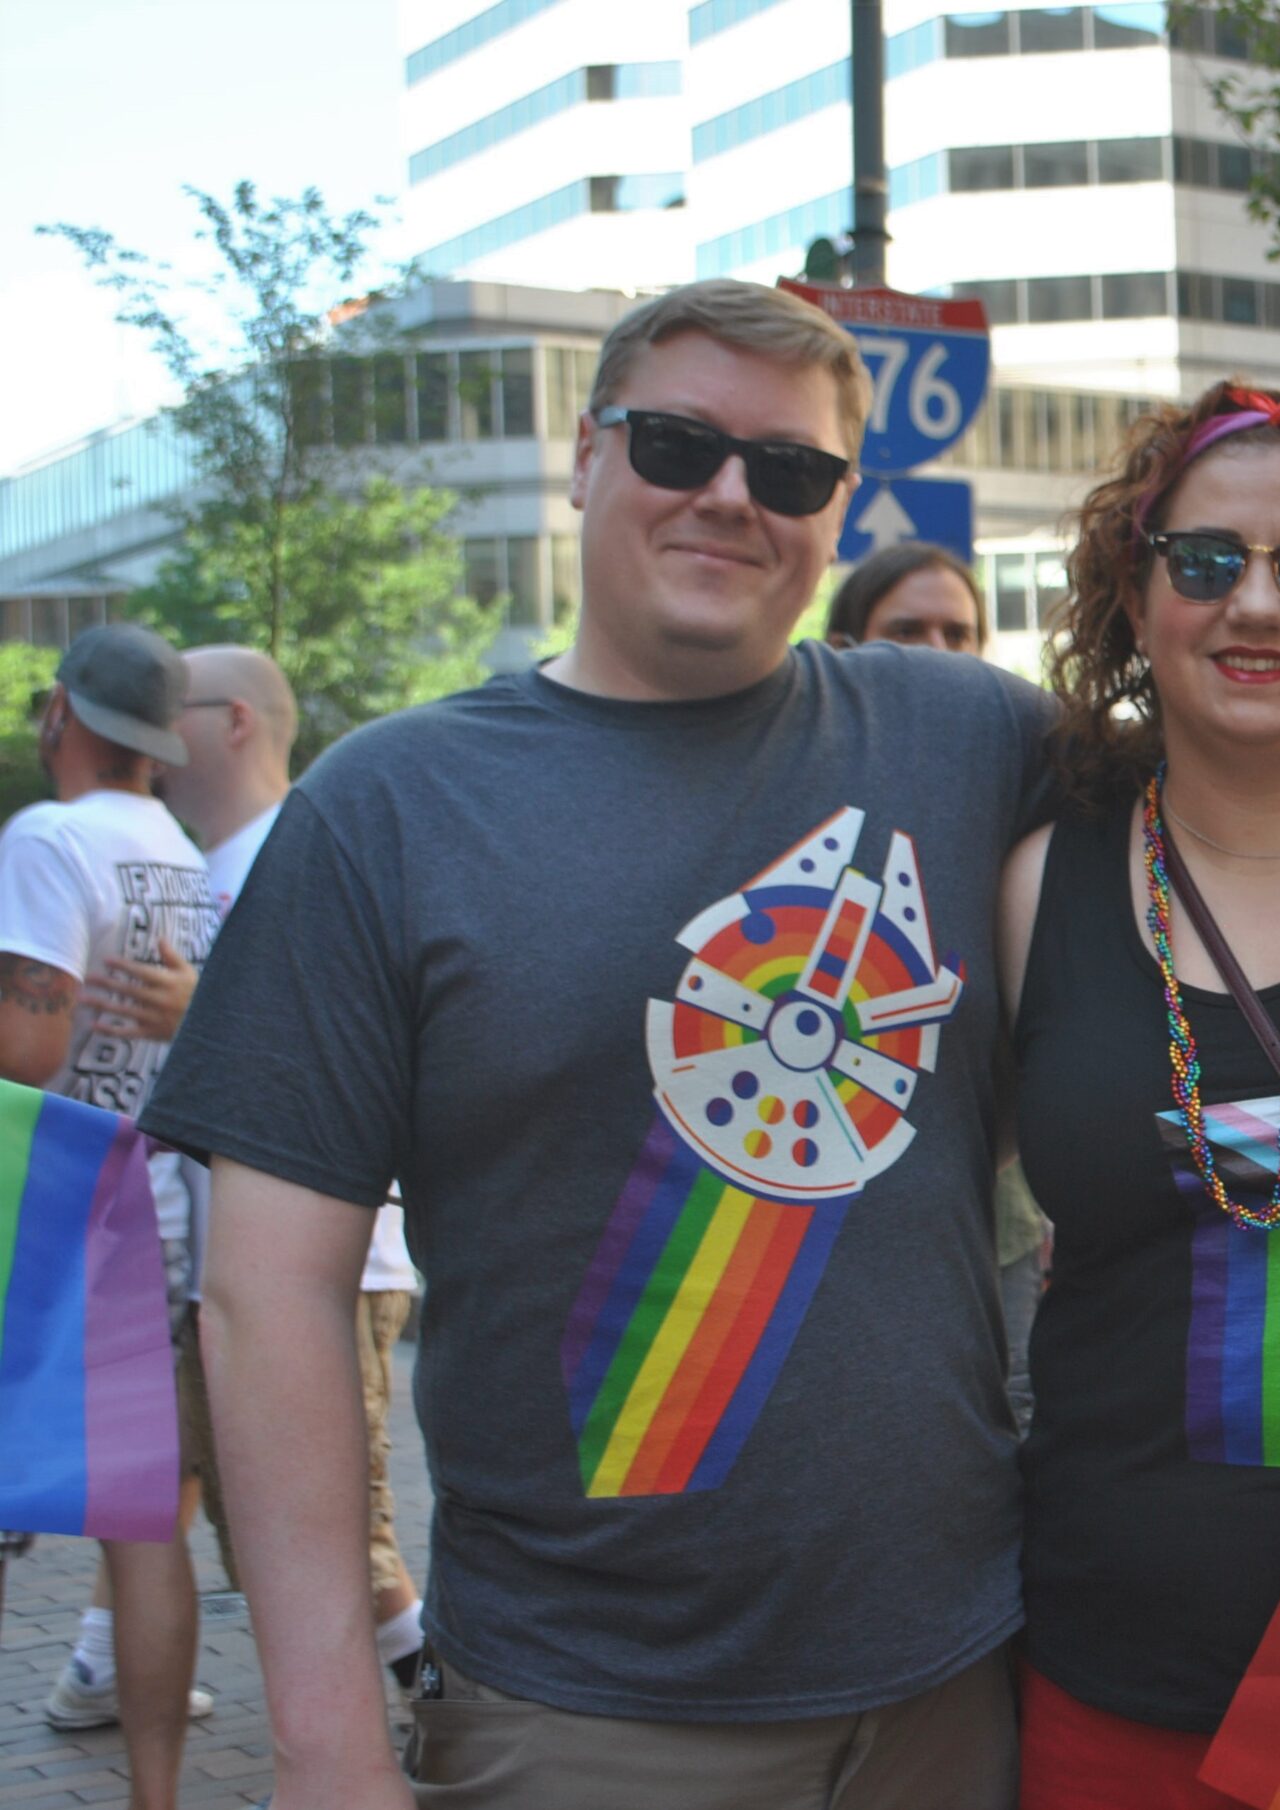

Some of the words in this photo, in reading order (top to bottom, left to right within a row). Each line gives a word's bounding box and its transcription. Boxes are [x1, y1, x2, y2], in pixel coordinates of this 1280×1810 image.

[822, 291, 944, 328] INTERSTATE
[857, 336, 963, 440] 76
[117, 863, 149, 904] IF
